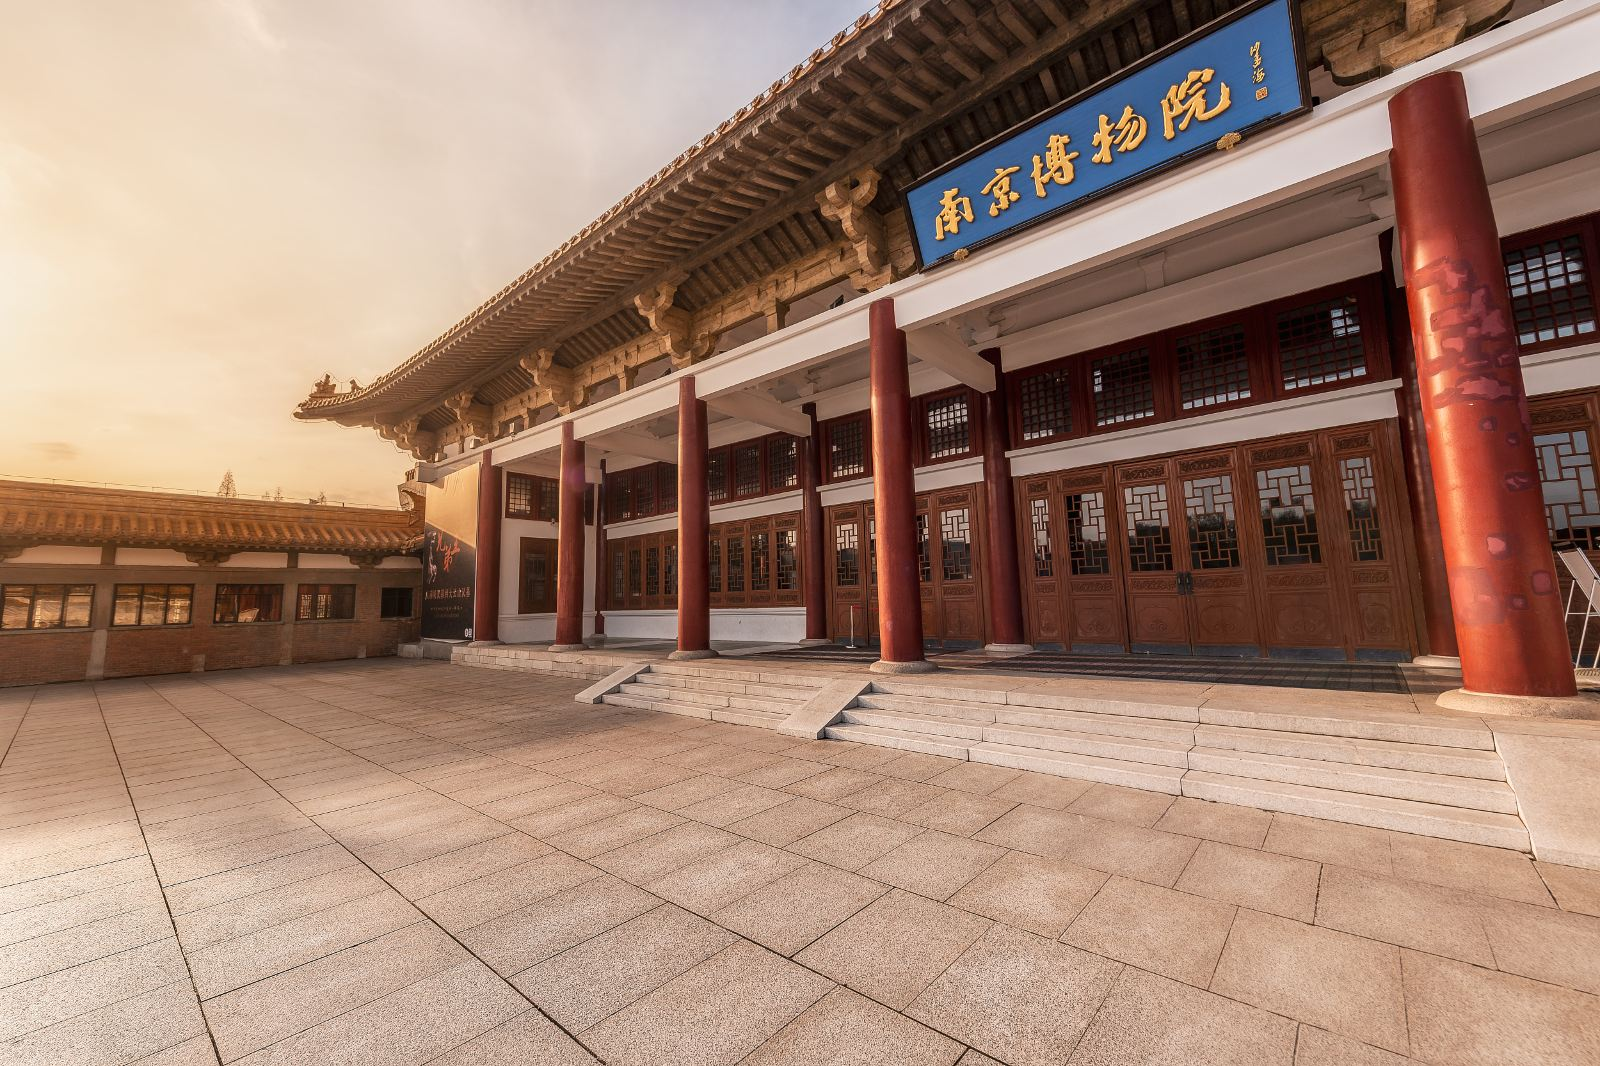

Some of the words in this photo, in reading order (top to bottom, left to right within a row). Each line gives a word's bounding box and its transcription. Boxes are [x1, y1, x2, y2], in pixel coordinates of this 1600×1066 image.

[934, 67, 1232, 241] 南京博物院
